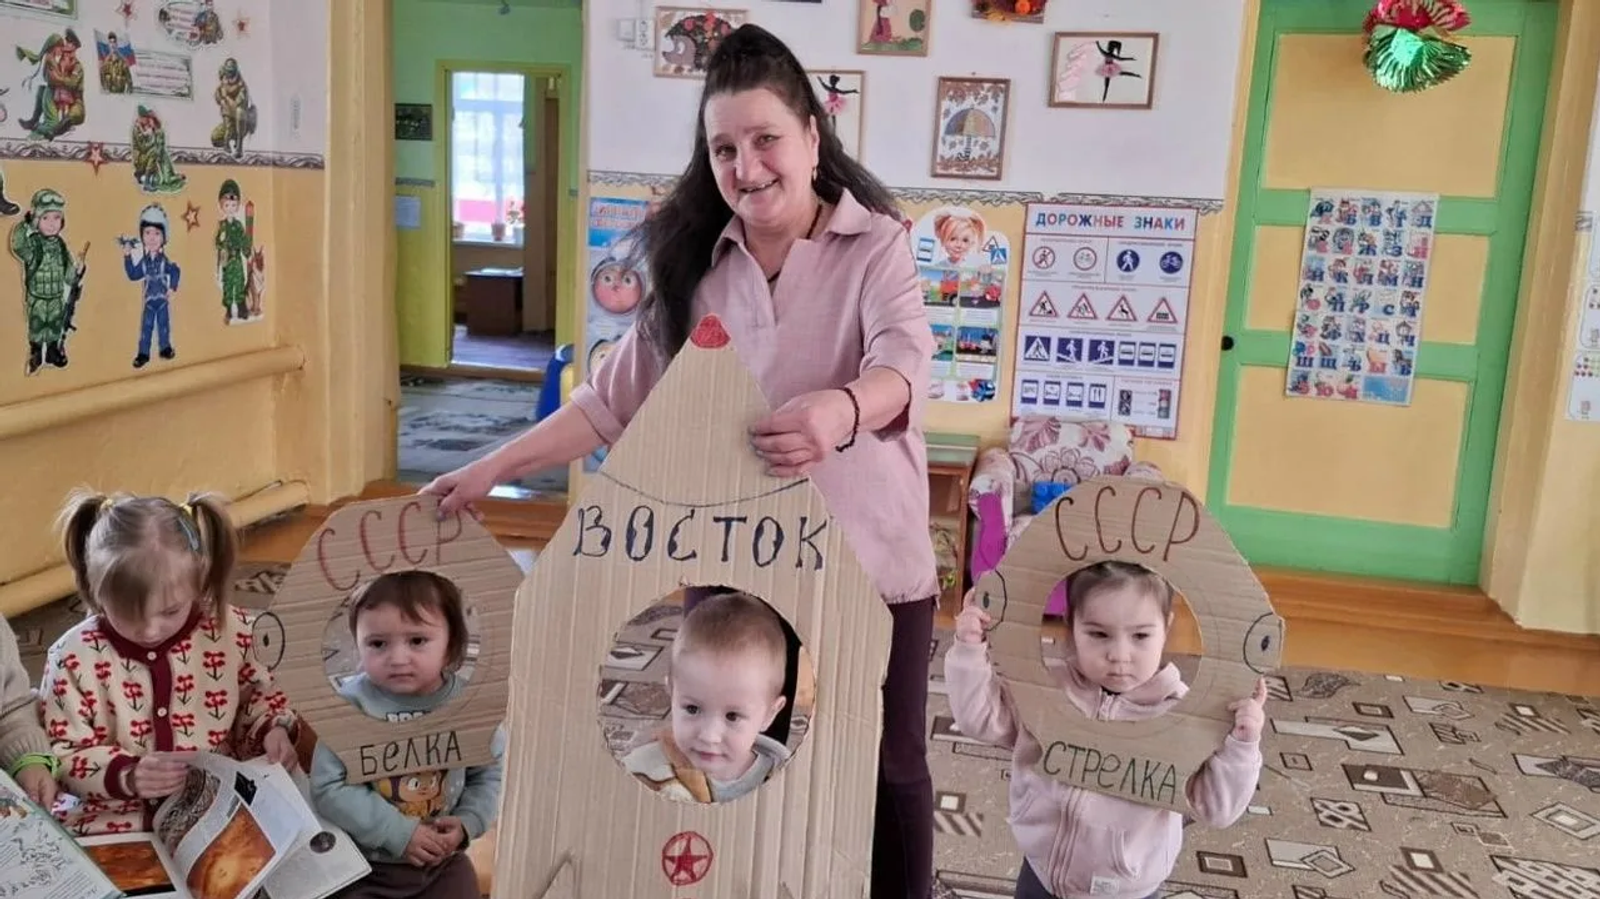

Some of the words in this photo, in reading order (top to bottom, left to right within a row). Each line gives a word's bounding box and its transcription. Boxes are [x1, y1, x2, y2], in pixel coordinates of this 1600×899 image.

[1035, 212, 1125, 229] ДОРОЖНЫЕ
[1133, 216, 1185, 231] ЗНАКИ
[317, 501, 463, 591] СССР
[573, 505, 828, 571] ВОСТОК
[1055, 485, 1201, 562] СССР
